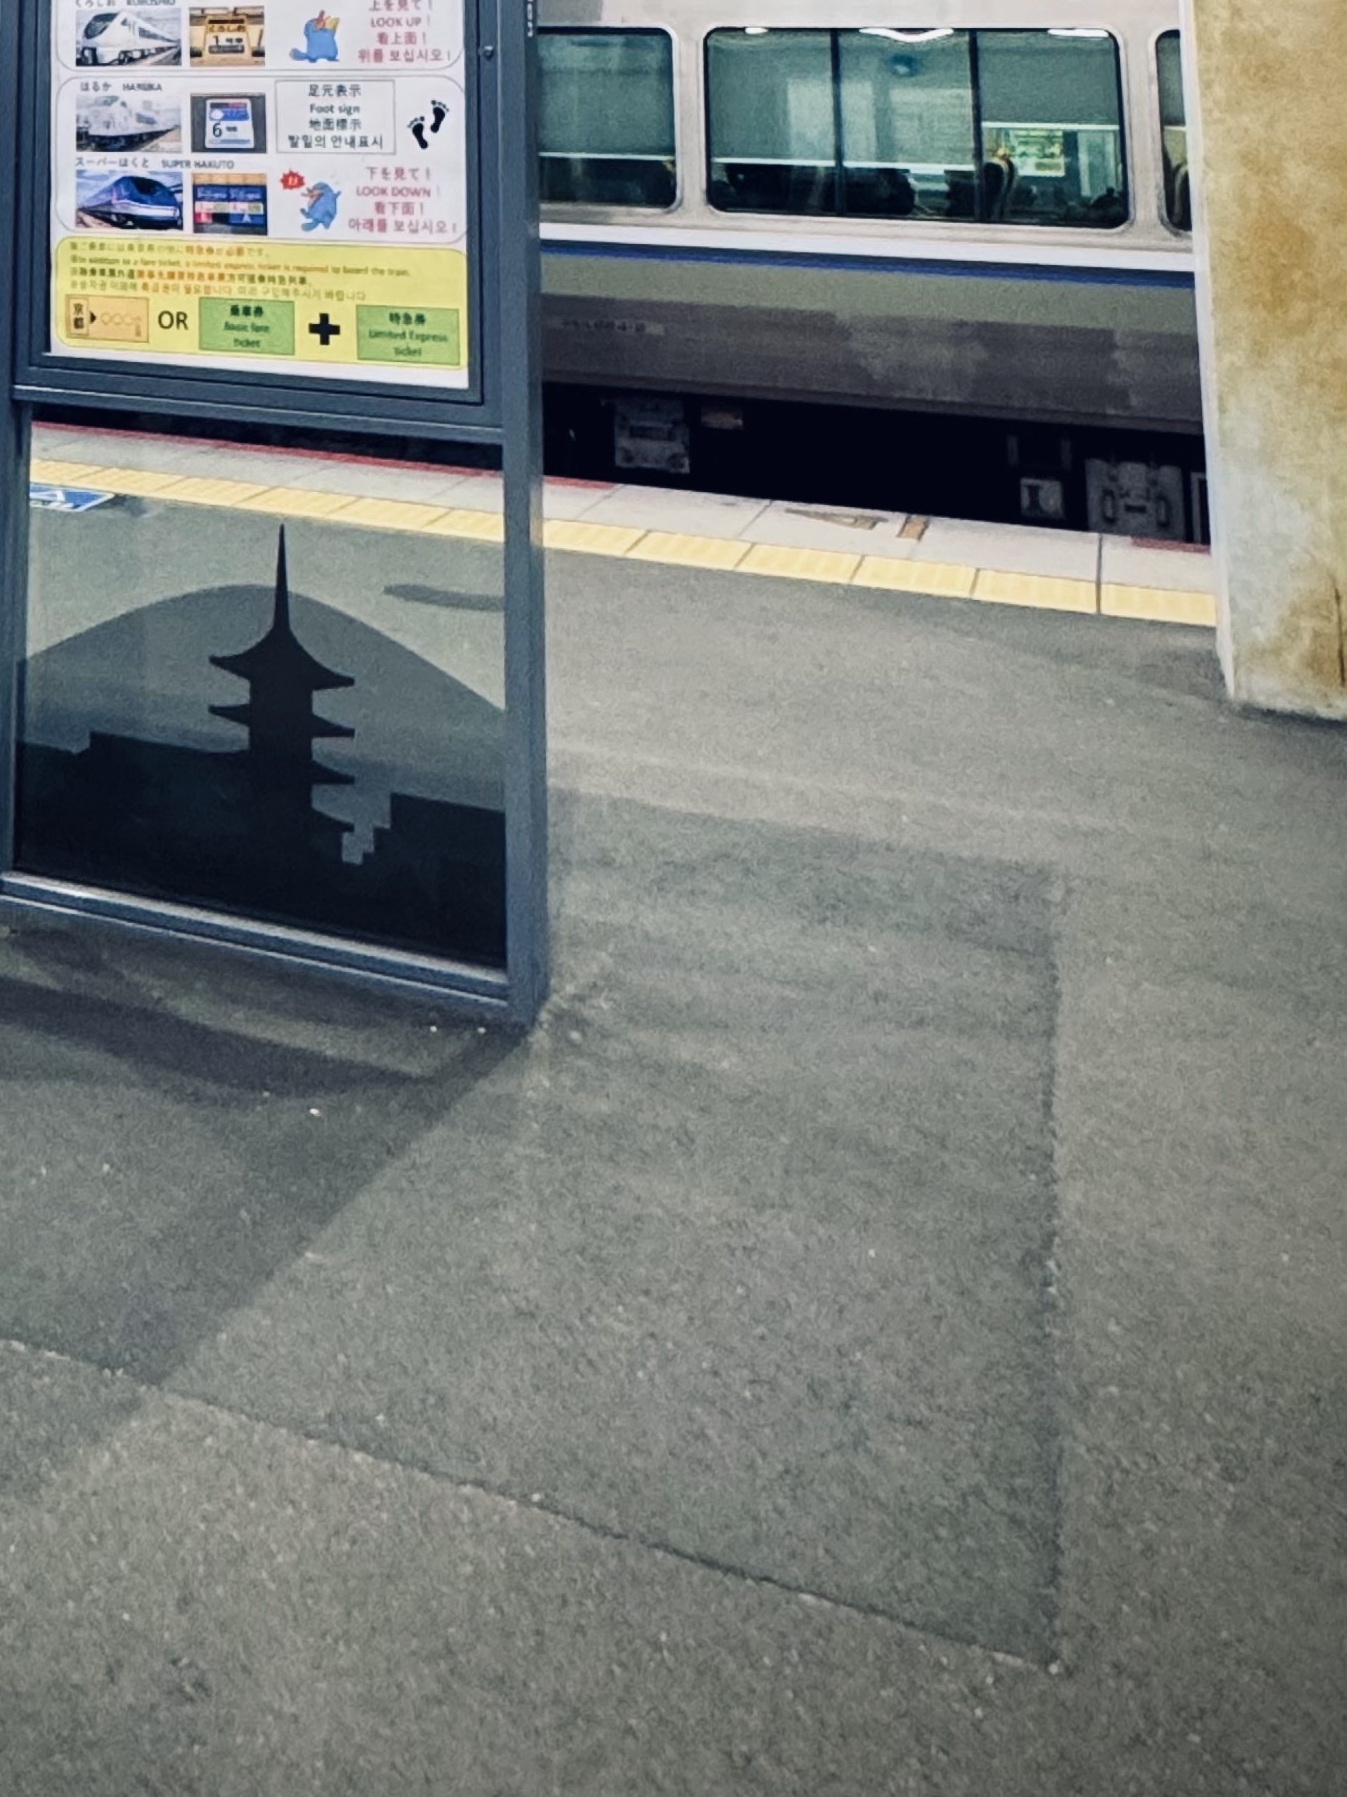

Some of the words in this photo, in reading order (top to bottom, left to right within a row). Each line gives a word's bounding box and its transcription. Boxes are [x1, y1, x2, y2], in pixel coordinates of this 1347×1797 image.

[370, 17, 403, 28] LOOK
[309, 104, 334, 114] Foot
[338, 104, 360, 115] sign
[212, 121, 223, 138] 6
[356, 186, 388, 197] LOOK
[158, 310, 189, 331] OR
